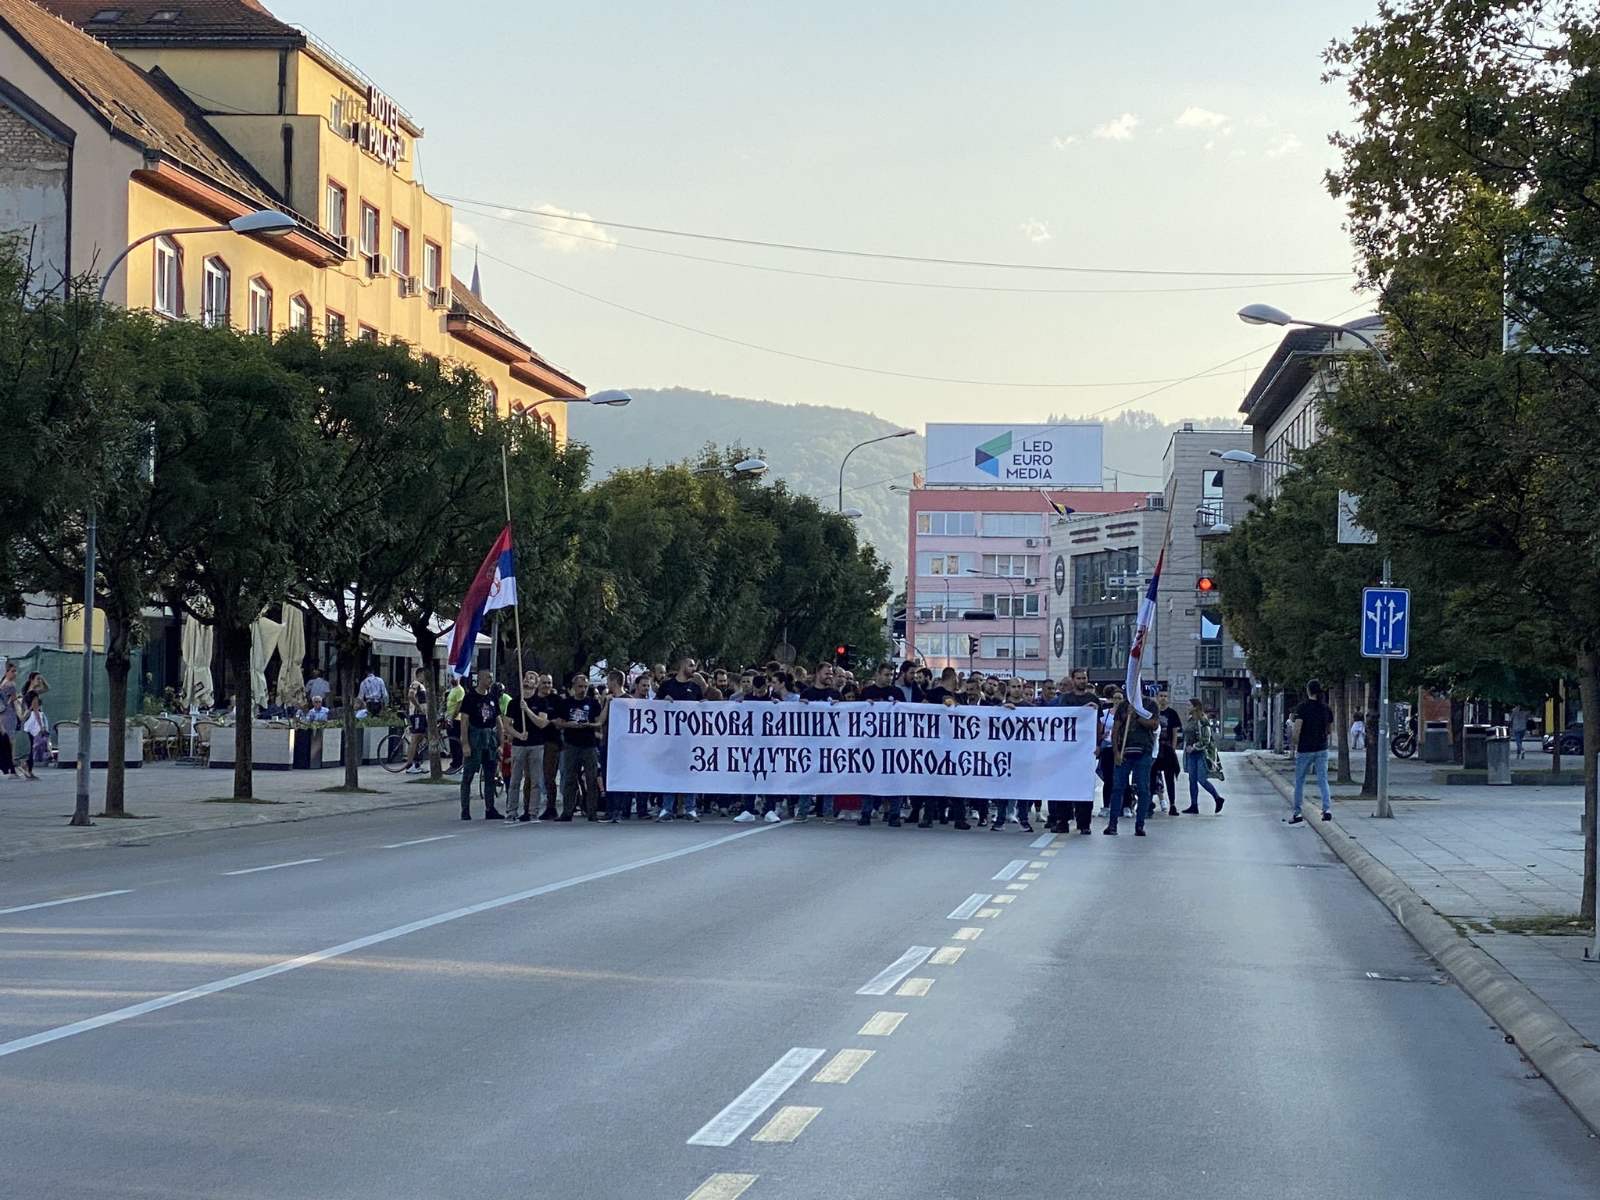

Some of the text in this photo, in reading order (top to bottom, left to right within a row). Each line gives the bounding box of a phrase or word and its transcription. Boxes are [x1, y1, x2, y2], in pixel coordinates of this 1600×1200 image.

[367, 85, 399, 133] HOTEL
[367, 121, 402, 172] PALACE
[1012, 454, 1053, 466] EURO
[1022, 440, 1053, 453] LED
[1005, 467, 1053, 480] MEDIA
[627, 708, 1078, 743] ИЗ ГРОБОВА ВАШИХ ИЗНИЋИ ЋЕ БОЖУРИ
[689, 746, 1012, 782] ЗА БУДУЋЕ НЕКО ПОКОЉЕЊЕ!
